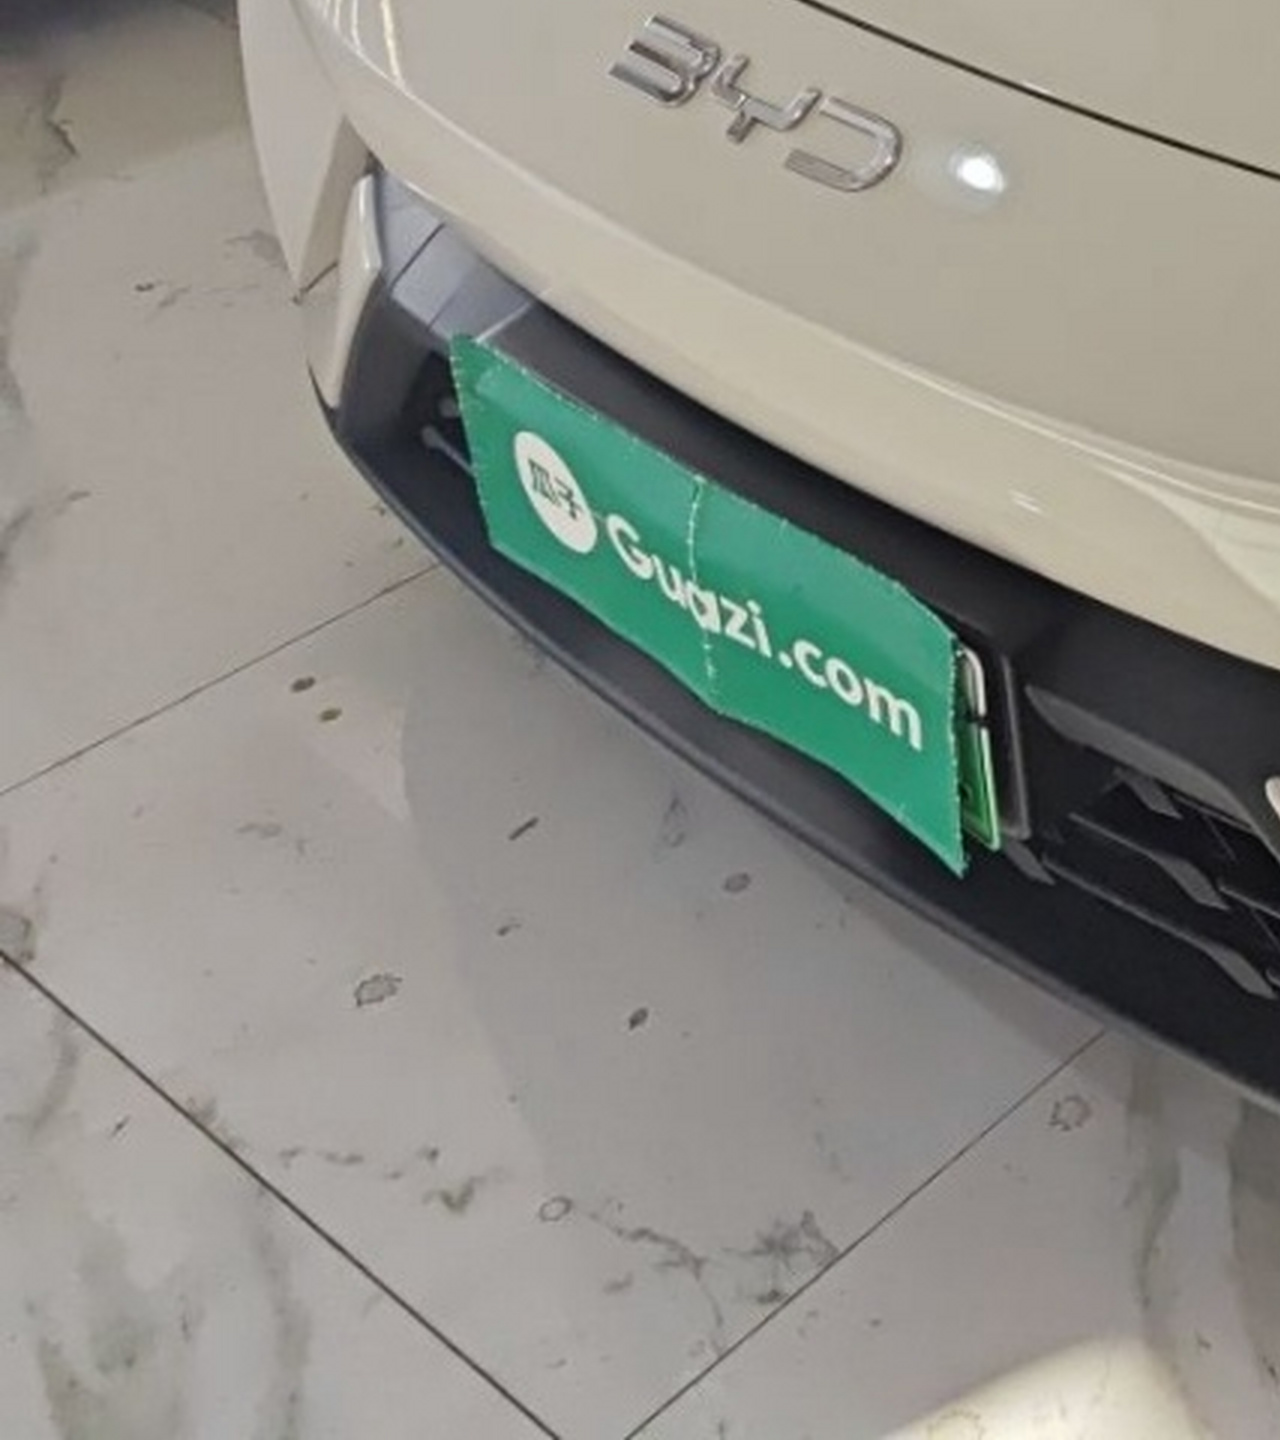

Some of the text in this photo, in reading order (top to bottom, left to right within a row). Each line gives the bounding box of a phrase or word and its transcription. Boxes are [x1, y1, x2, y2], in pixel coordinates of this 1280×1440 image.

[609, 15, 903, 193] BYD
[528, 457, 583, 521] 瓜子
[607, 515, 923, 749] Guazi.com
